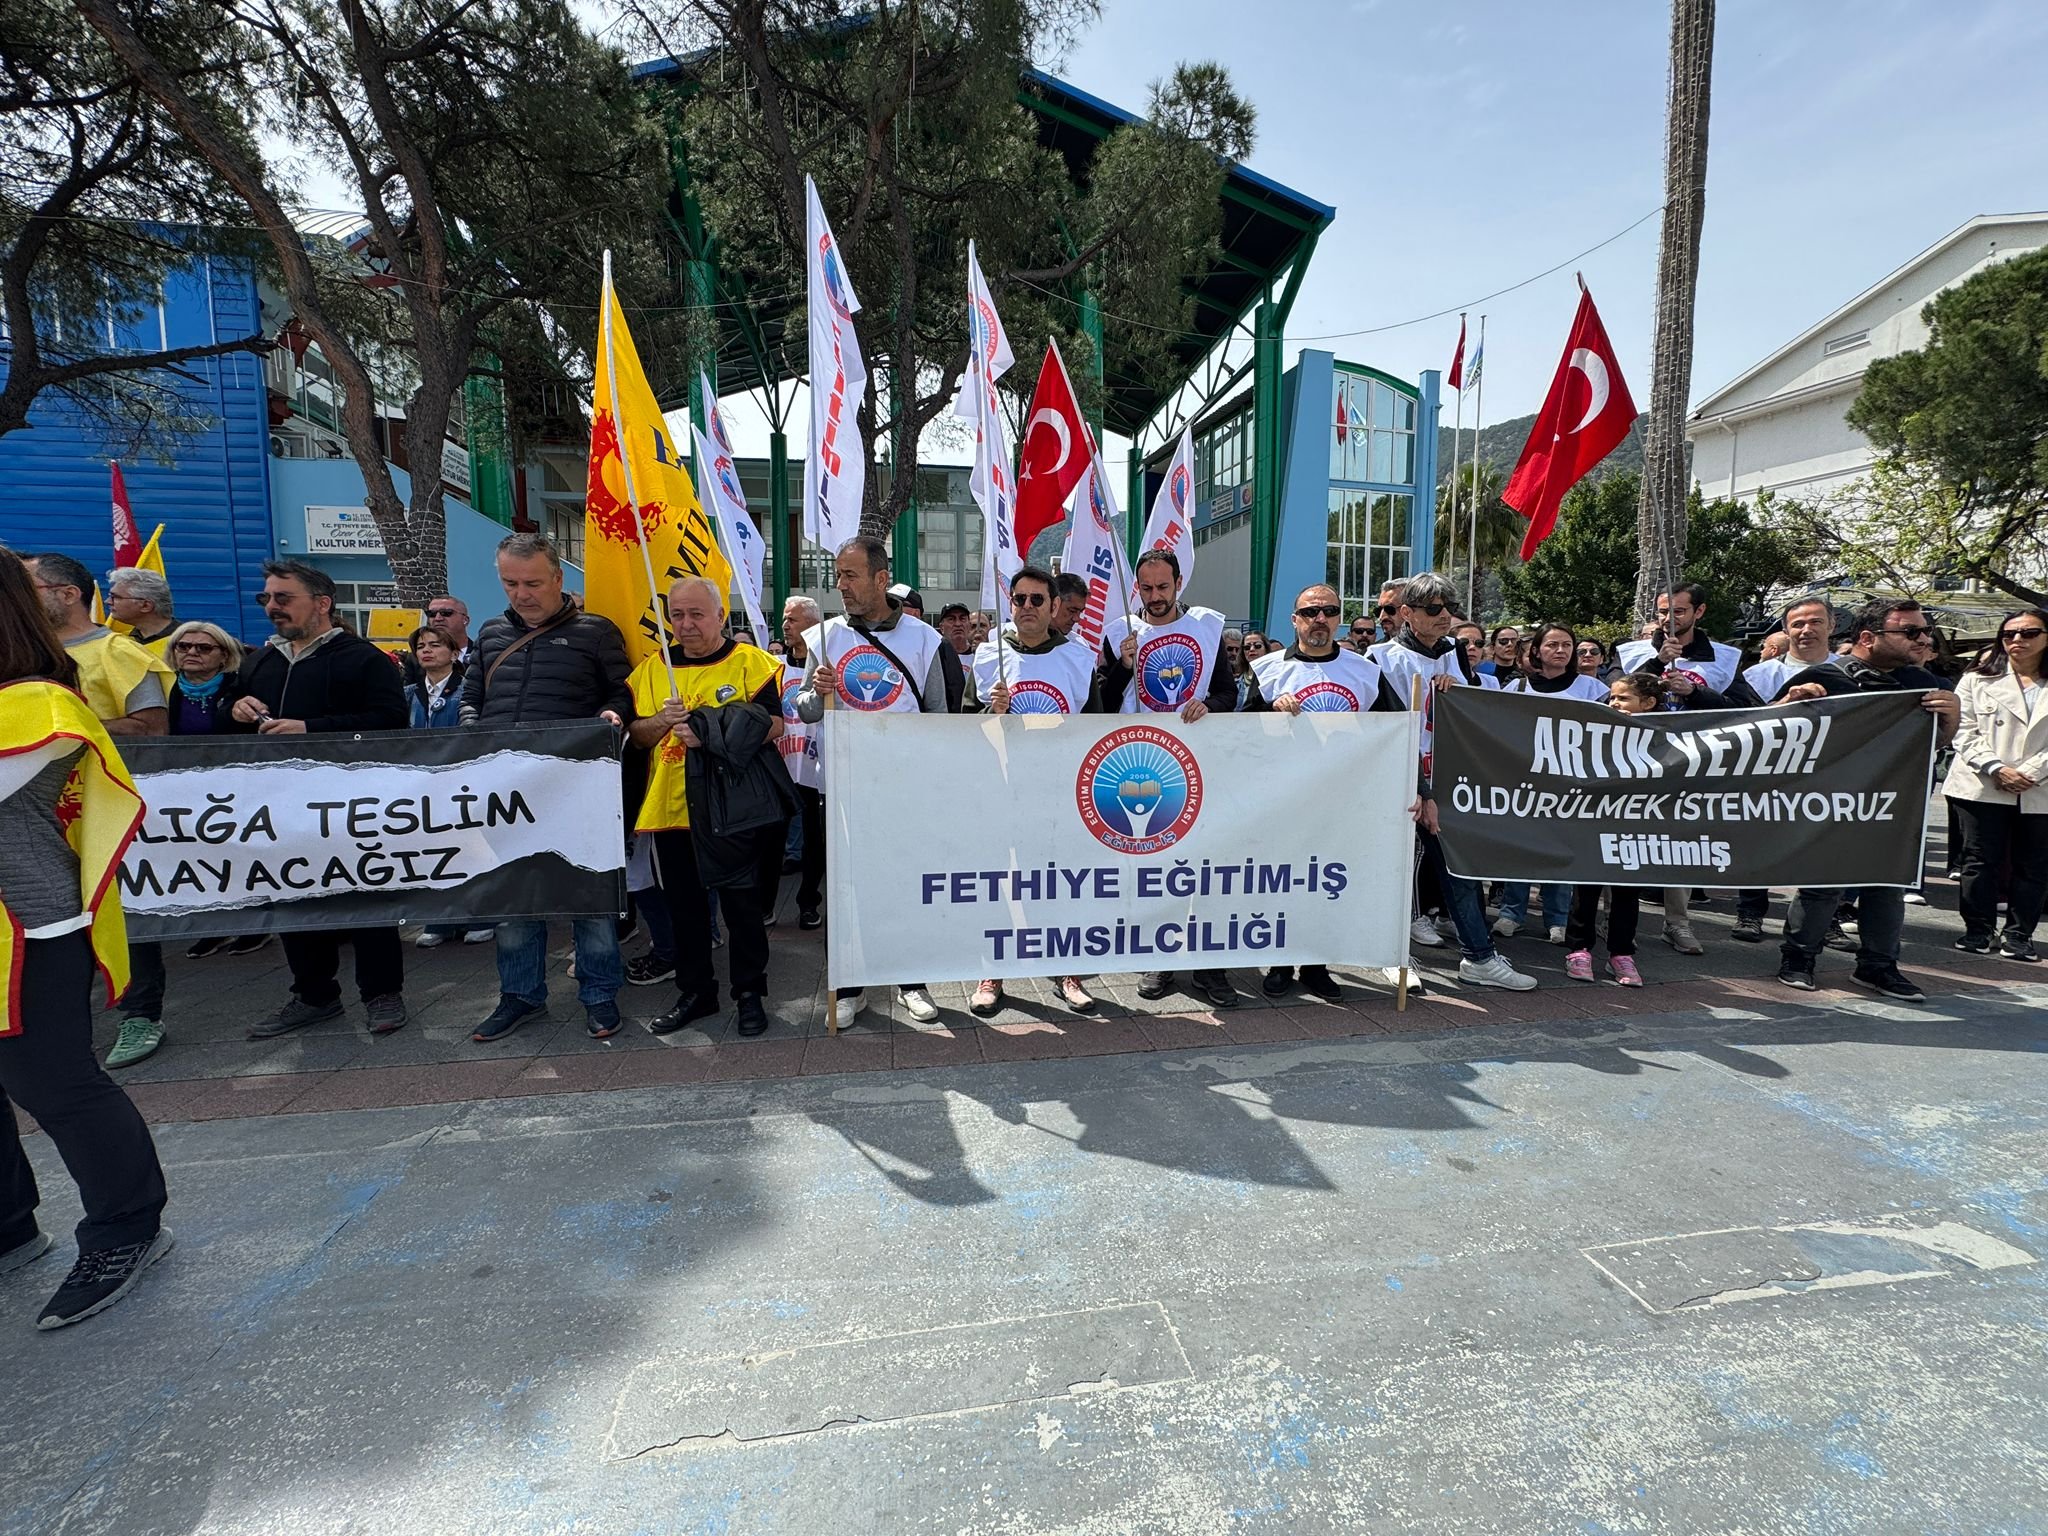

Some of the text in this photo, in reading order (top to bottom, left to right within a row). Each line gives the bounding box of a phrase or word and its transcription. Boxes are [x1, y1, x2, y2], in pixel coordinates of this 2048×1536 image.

[358, 539, 384, 549] MER
[1530, 715, 1832, 779] ARTIK YETER!
[1081, 728, 1199, 826] EĞİTİM VE BİLİM İŞGÖRENLERİ SENDİKASI
[1452, 776, 1671, 820] ÖLDÜRÜLMEK
[136, 784, 536, 844] LIĞA TESLİM
[1101, 831, 1177, 852] EĞİTİM-İŞ
[1599, 832, 1731, 872] Eğitimiş
[118, 843, 469, 897] MAYACAĞIZ
[921, 855, 1349, 904] FETHİYE EĞİTİM-İŞ
[984, 912, 1287, 961] TEMSİLCİLİĞİ
